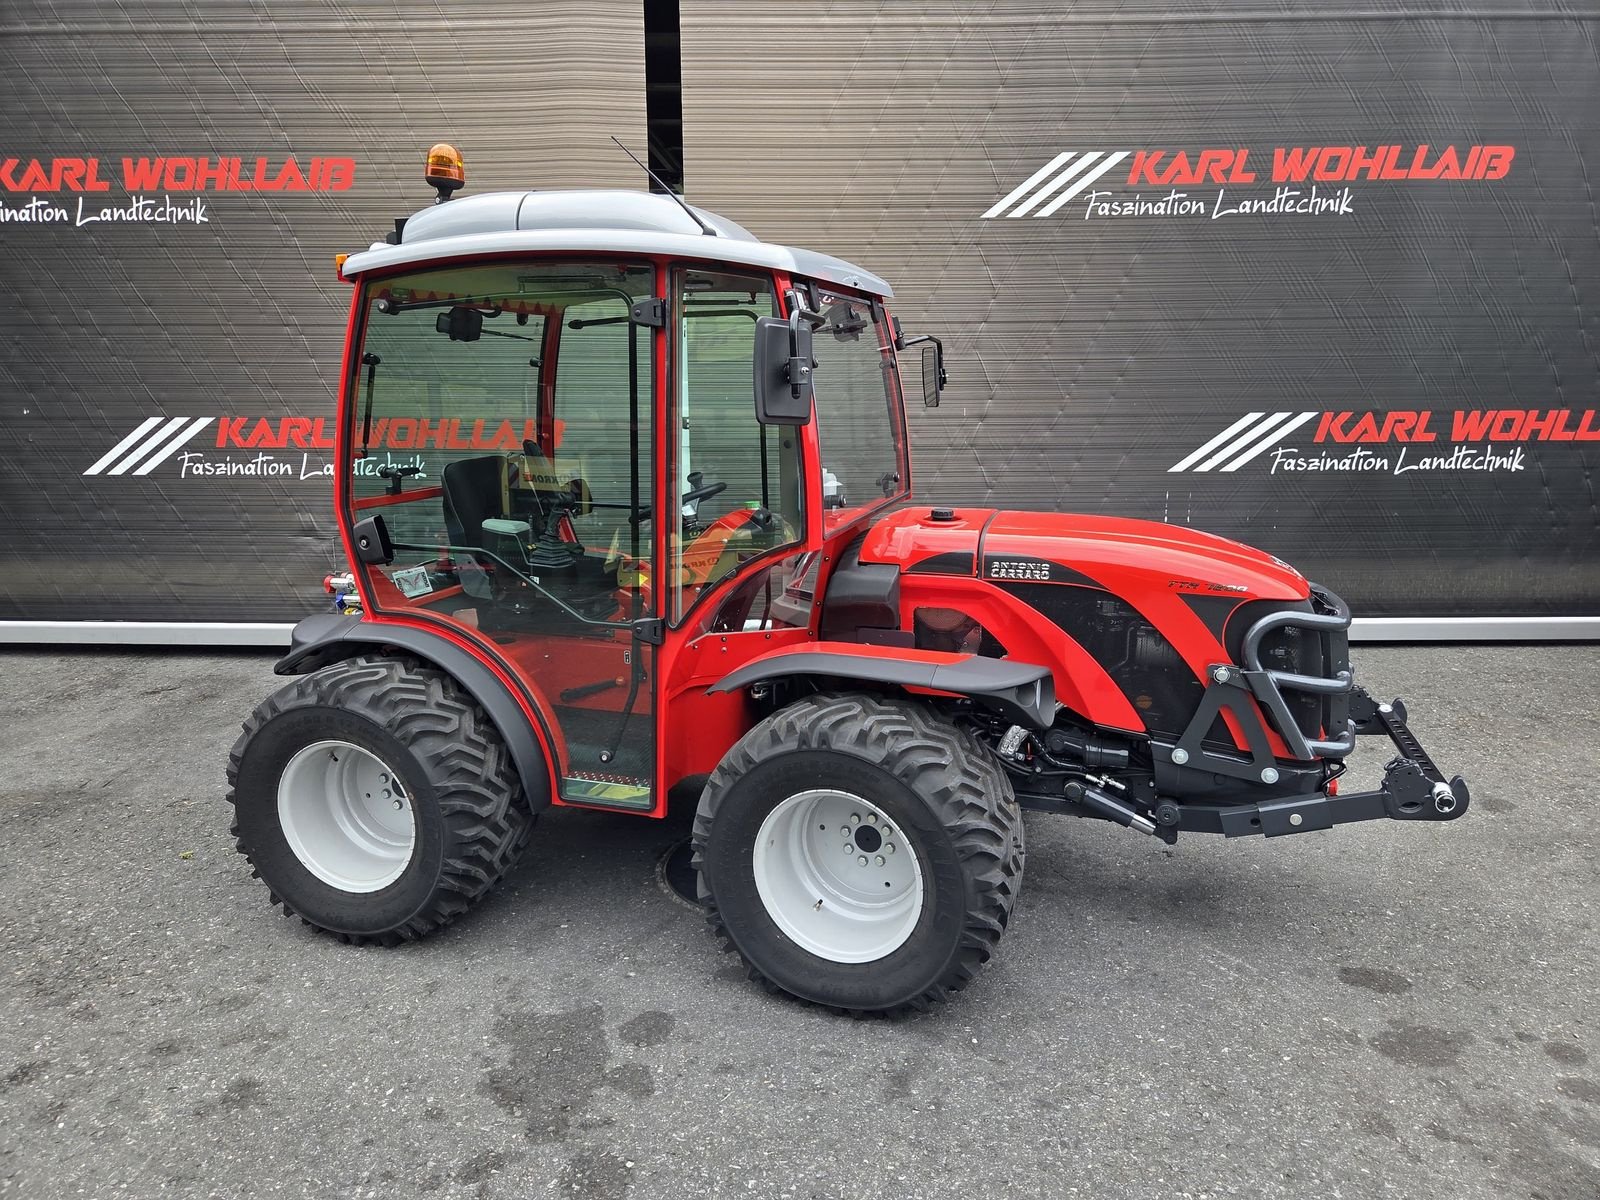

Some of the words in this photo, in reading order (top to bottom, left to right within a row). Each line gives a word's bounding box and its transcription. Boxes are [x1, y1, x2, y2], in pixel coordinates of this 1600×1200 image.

[1128, 149, 1256, 185] KARL
[76, 194, 209, 227] Landtechnik
[1084, 189, 1205, 220] Faszination
[1211, 185, 1354, 220] Landtechnik
[216, 416, 335, 449] KARL
[1313, 410, 1437, 443] KARL
[178, 451, 293, 479] Faszination
[1270, 446, 1388, 475] Faszination
[1394, 446, 1525, 475] Landtechnik
[991, 561, 1050, 571] ANTONIO
[991, 568, 1050, 580] CARRARO
